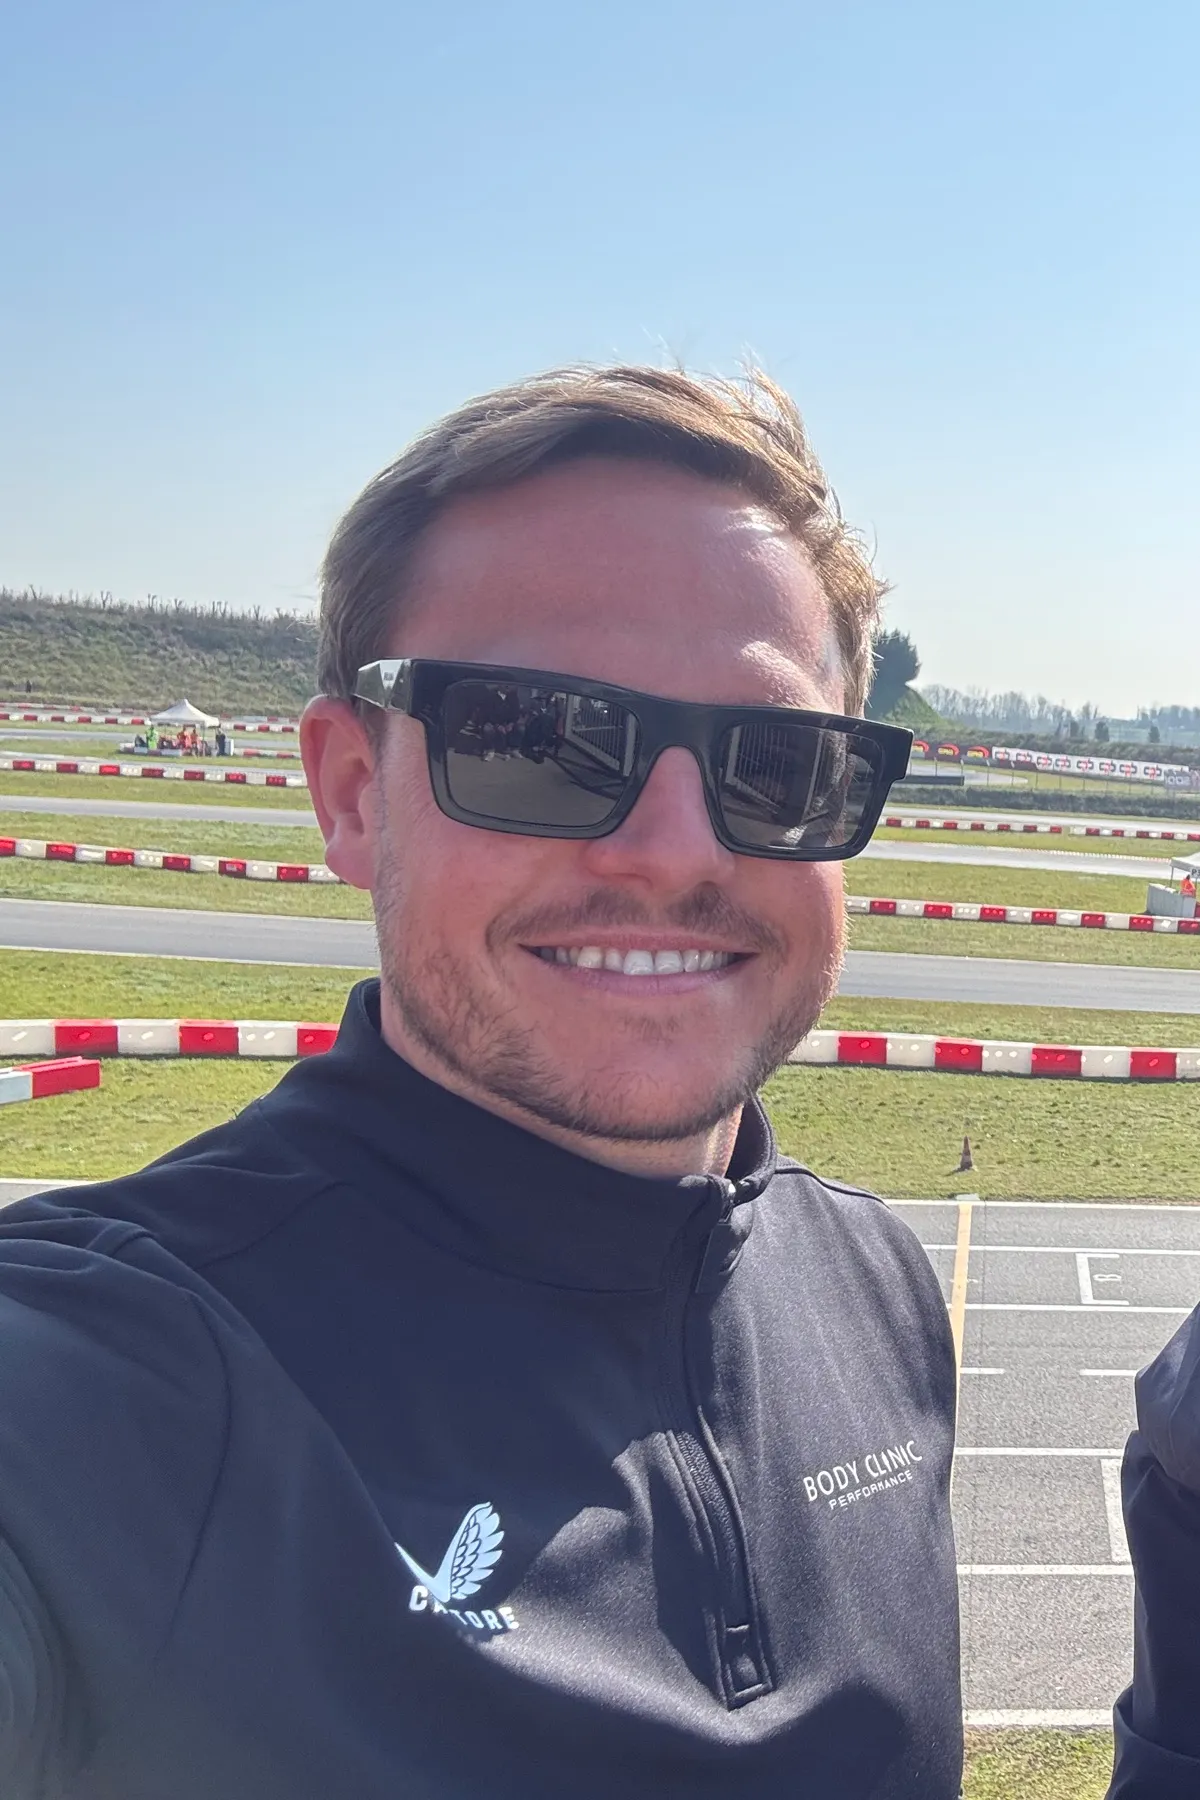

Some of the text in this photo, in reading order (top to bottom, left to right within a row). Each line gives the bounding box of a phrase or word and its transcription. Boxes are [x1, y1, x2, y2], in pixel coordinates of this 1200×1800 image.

[803, 1440, 923, 1502] BODY CLINIC
[828, 1469, 913, 1511] PERFORMANCE
